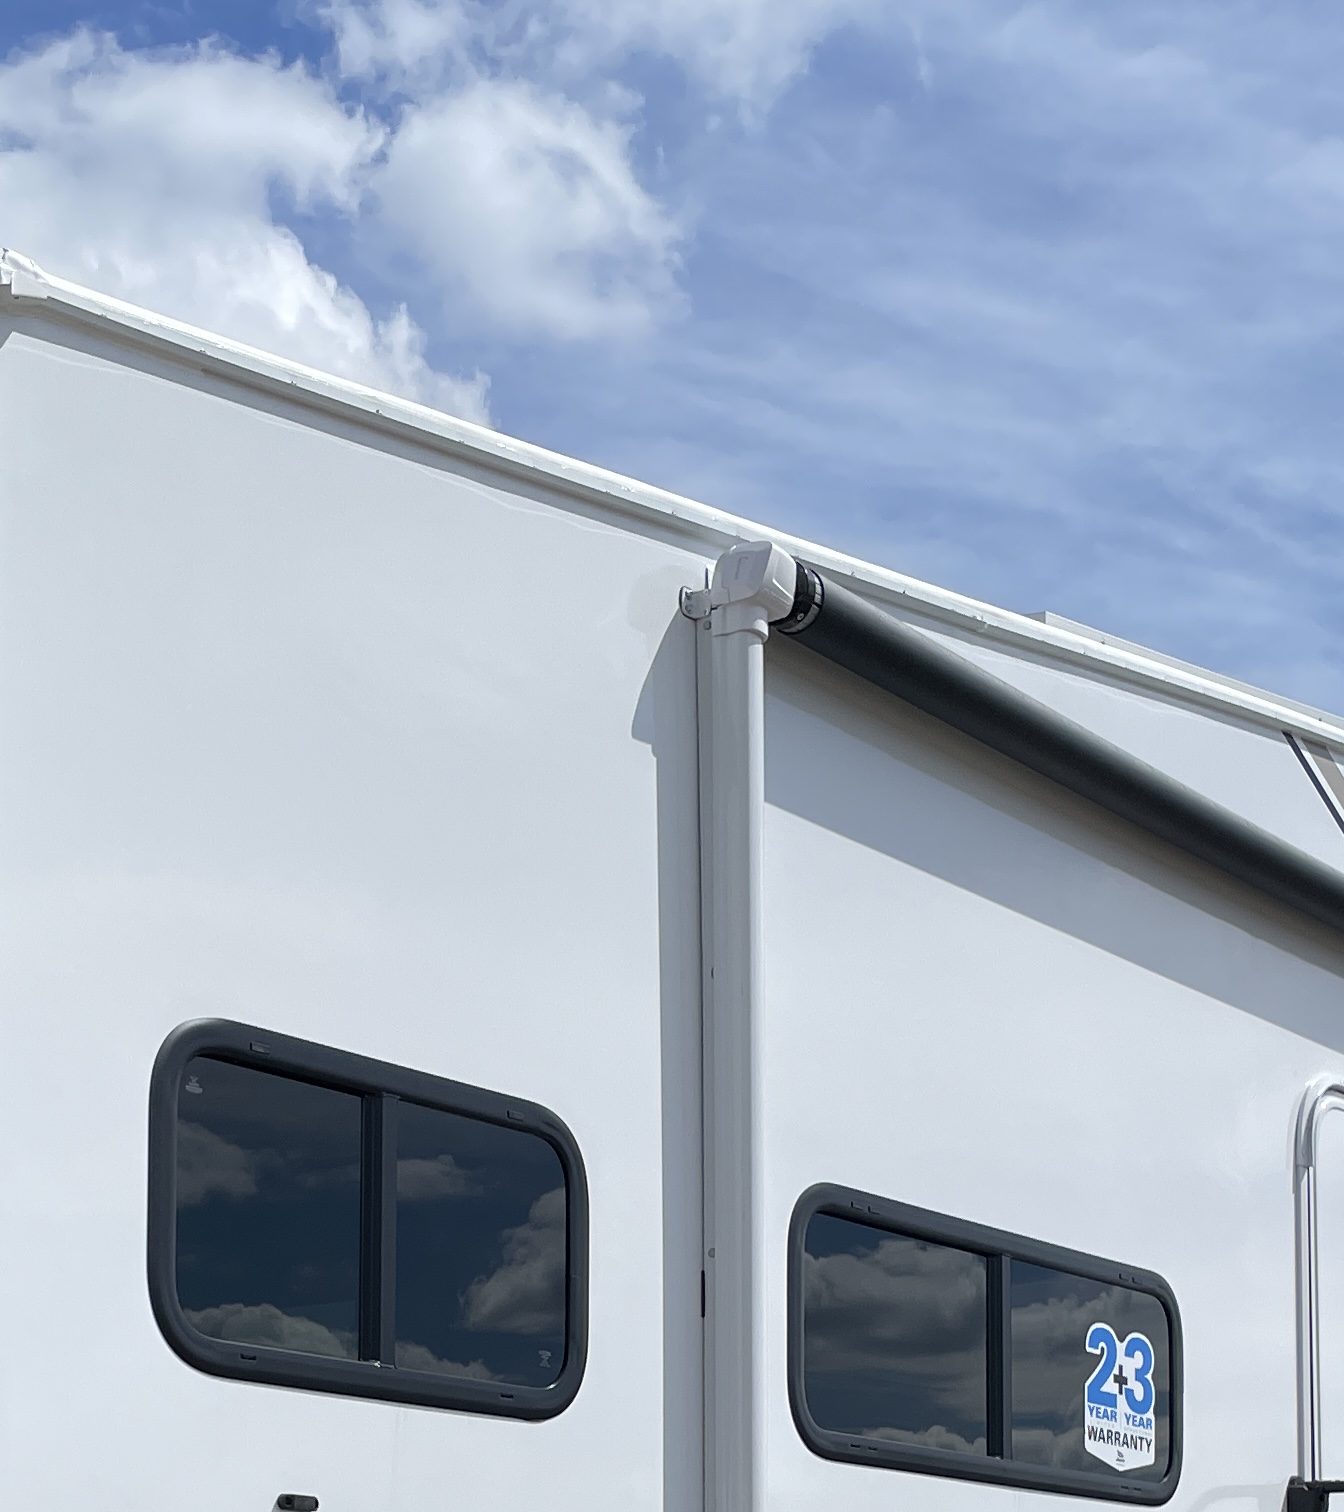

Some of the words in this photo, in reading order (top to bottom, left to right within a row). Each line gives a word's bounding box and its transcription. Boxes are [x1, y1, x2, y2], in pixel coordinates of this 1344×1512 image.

[1088, 1404, 1118, 1423] YEAR
[1124, 1412, 1153, 1430] YEAR
[1087, 1425, 1153, 1453] WARRANTY
